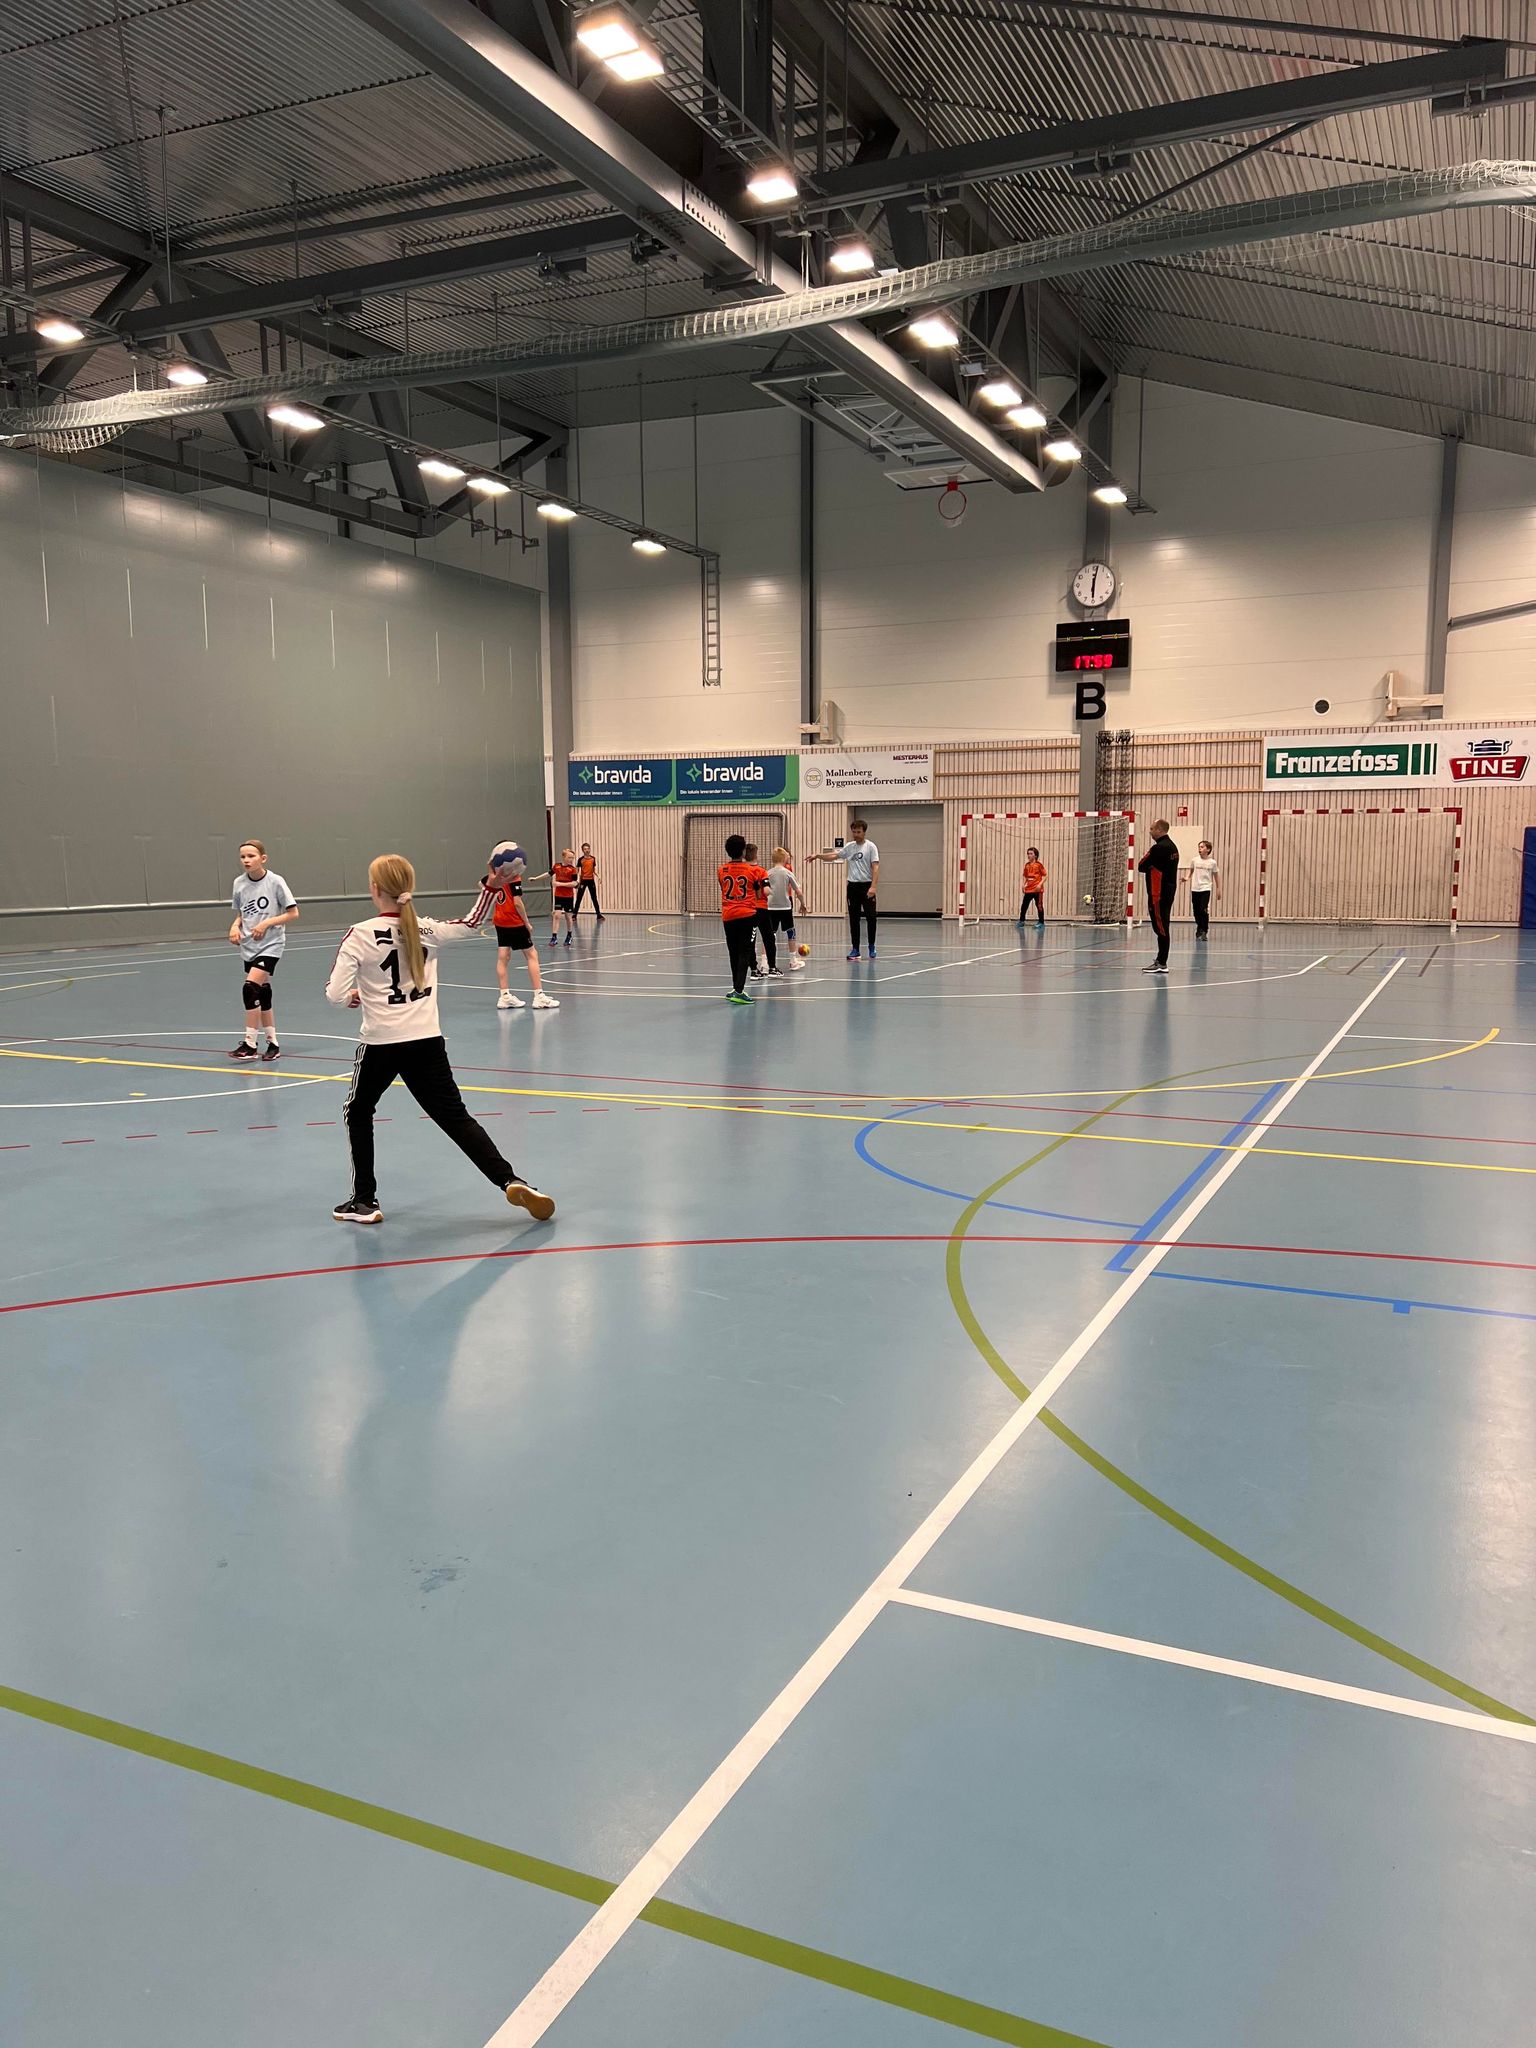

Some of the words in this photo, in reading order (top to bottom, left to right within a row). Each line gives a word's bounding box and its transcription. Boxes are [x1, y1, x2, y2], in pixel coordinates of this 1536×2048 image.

[1076, 682, 1107, 720] B
[703, 761, 764, 782] bravida
[1275, 749, 1399, 774] Franzefoss
[1456, 759, 1516, 775] TINE
[594, 765, 652, 784] bravida
[825, 777, 916, 788] Byggmesterforretning
[917, 776, 928, 784] AS
[722, 875, 748, 901] 23
